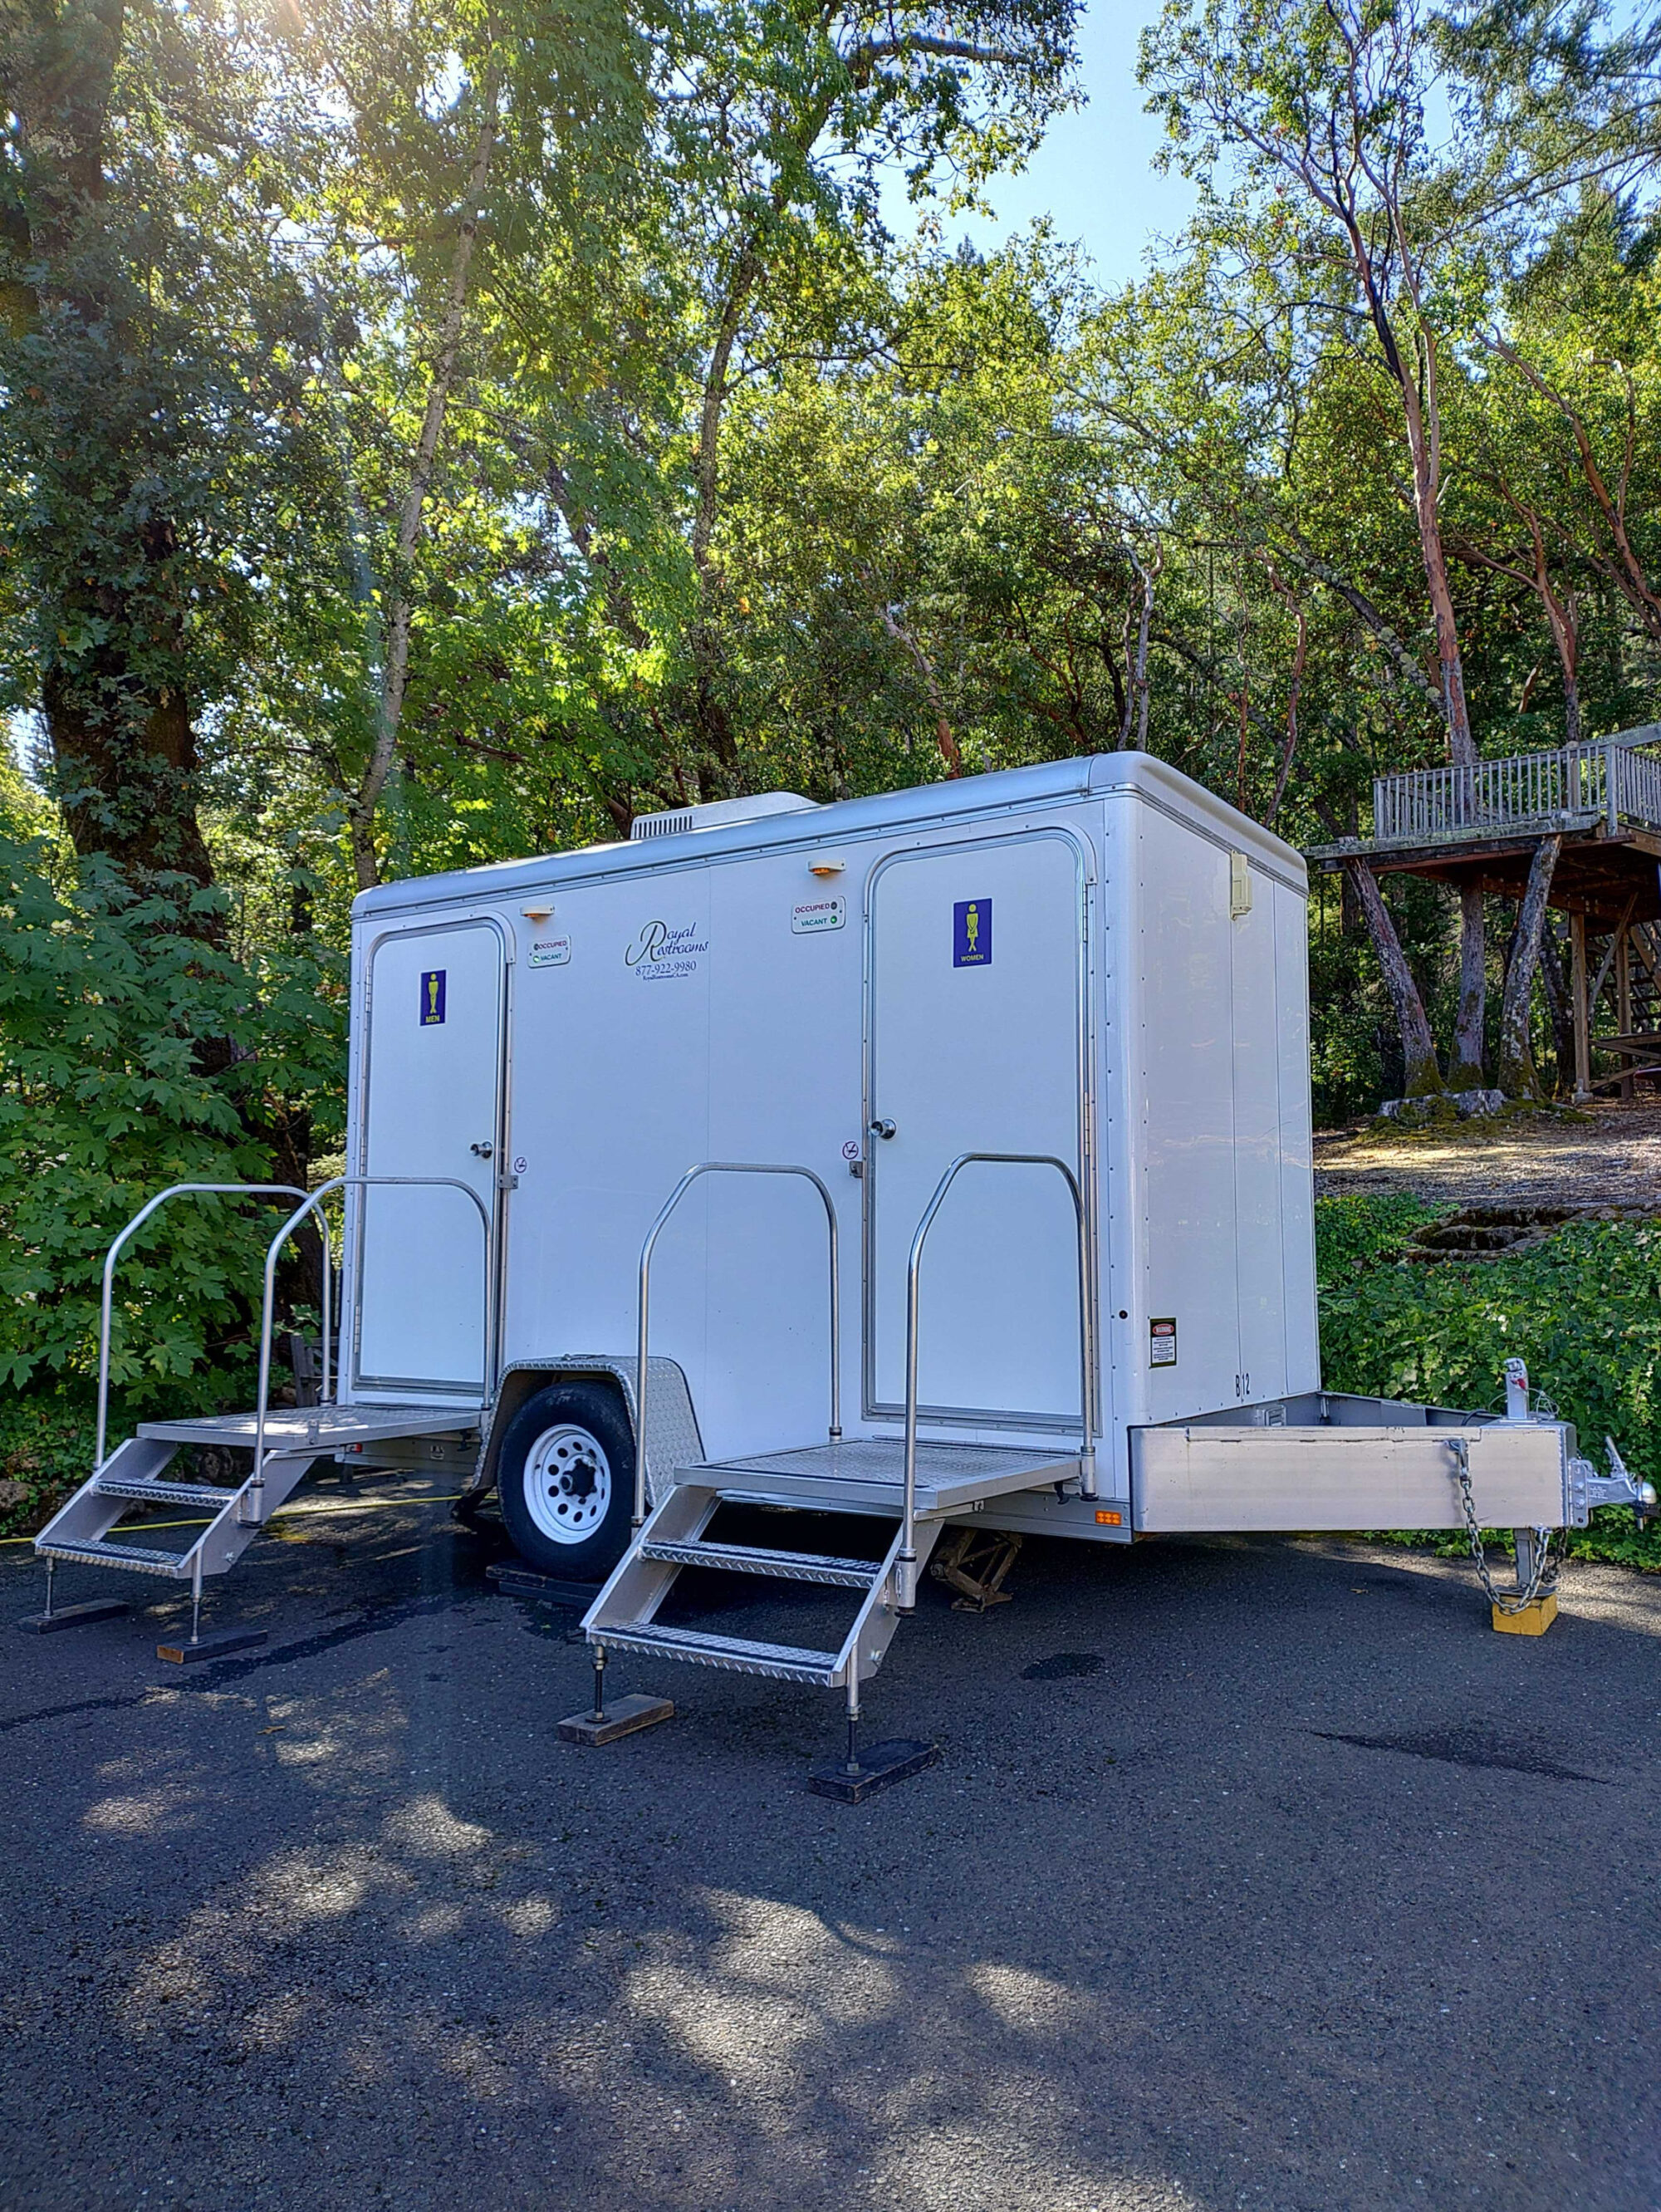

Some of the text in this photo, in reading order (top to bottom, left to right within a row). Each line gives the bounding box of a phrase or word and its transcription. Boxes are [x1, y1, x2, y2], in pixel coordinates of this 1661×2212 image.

[795, 903, 830, 914] OCCUPIED
[801, 917, 828, 926] VACANT
[537, 940, 567, 950] OCCUPIED
[625, 920, 696, 966] Royal
[540, 953, 562, 961] VACANT
[960, 954, 984, 963] WOMEN
[635, 960, 697, 976] 877-922-9980
[425, 1014, 440, 1023] MEN
